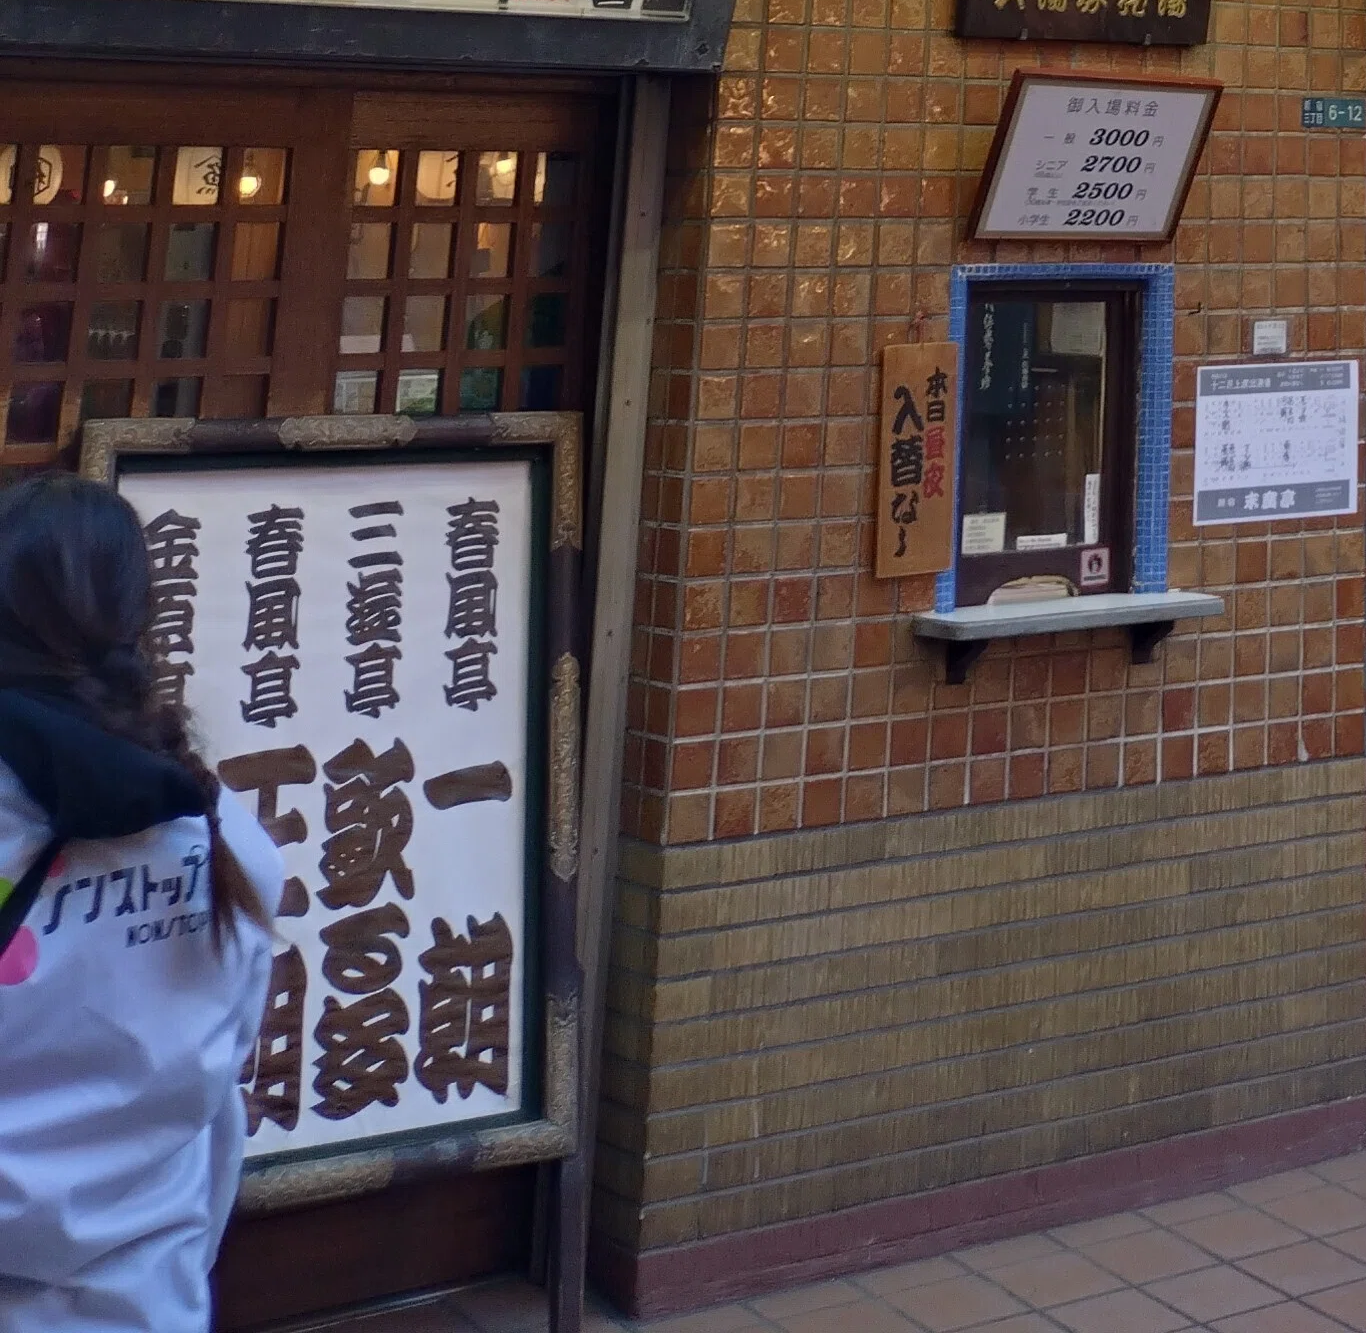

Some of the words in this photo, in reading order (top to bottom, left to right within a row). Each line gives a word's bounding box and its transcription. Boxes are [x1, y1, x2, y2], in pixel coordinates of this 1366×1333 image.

[1066, 96, 1160, 118] 御入場料金
[1328, 104, 1362, 121] 6-12
[1088, 127, 1151, 147] 3000
[1034, 159, 1069, 171] シニア
[1080, 155, 1143, 173] 2700
[1072, 181, 1134, 200] 2500
[1016, 214, 1050, 226] 小学生
[1063, 208, 1126, 226] 2200
